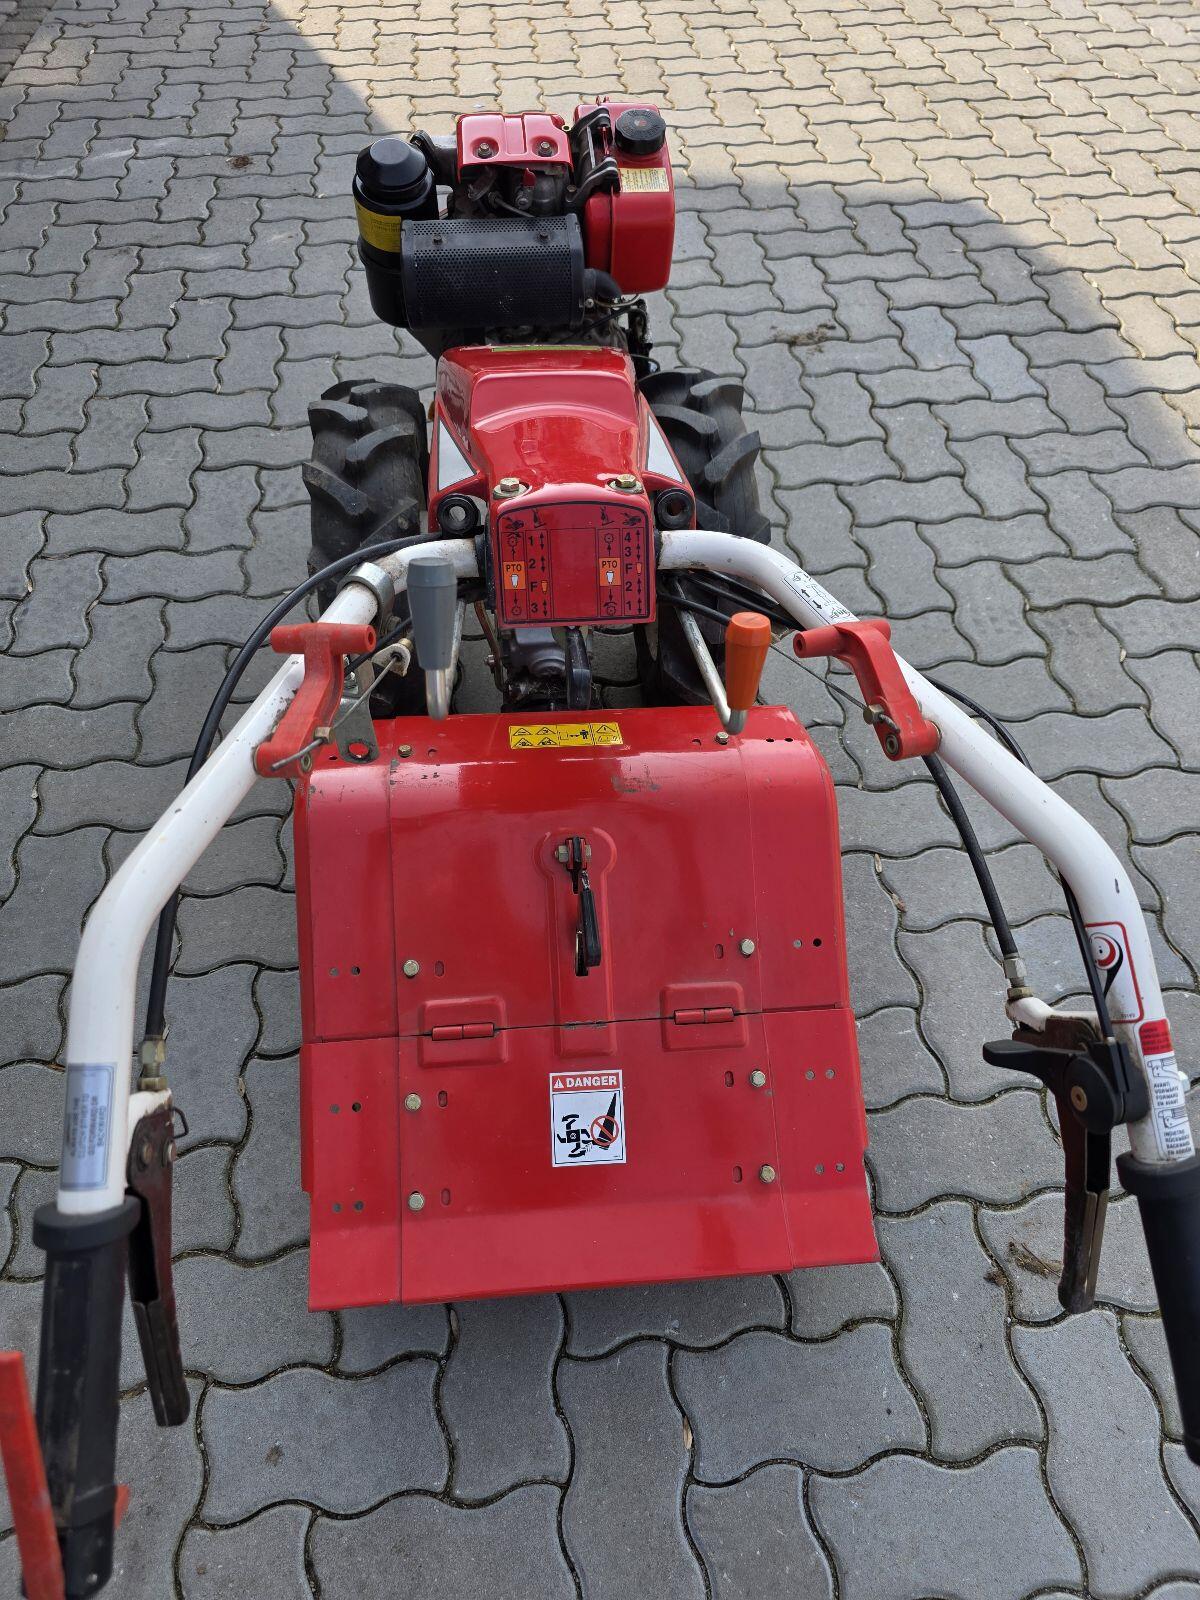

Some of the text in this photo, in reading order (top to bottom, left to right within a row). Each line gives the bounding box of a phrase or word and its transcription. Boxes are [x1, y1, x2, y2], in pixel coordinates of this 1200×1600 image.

[528, 535, 535, 547] 1
[624, 532, 632, 543] 4
[624, 546, 633, 558] 3
[505, 563, 522, 572] PTO
[528, 558, 537, 569] 2
[601, 560, 618, 569] PTO
[625, 563, 633, 575] F
[530, 581, 538, 592] F
[625, 581, 633, 592] 2
[530, 602, 539, 614] 3
[625, 600, 632, 611] 1
[566, 1075, 618, 1088] DANGER
